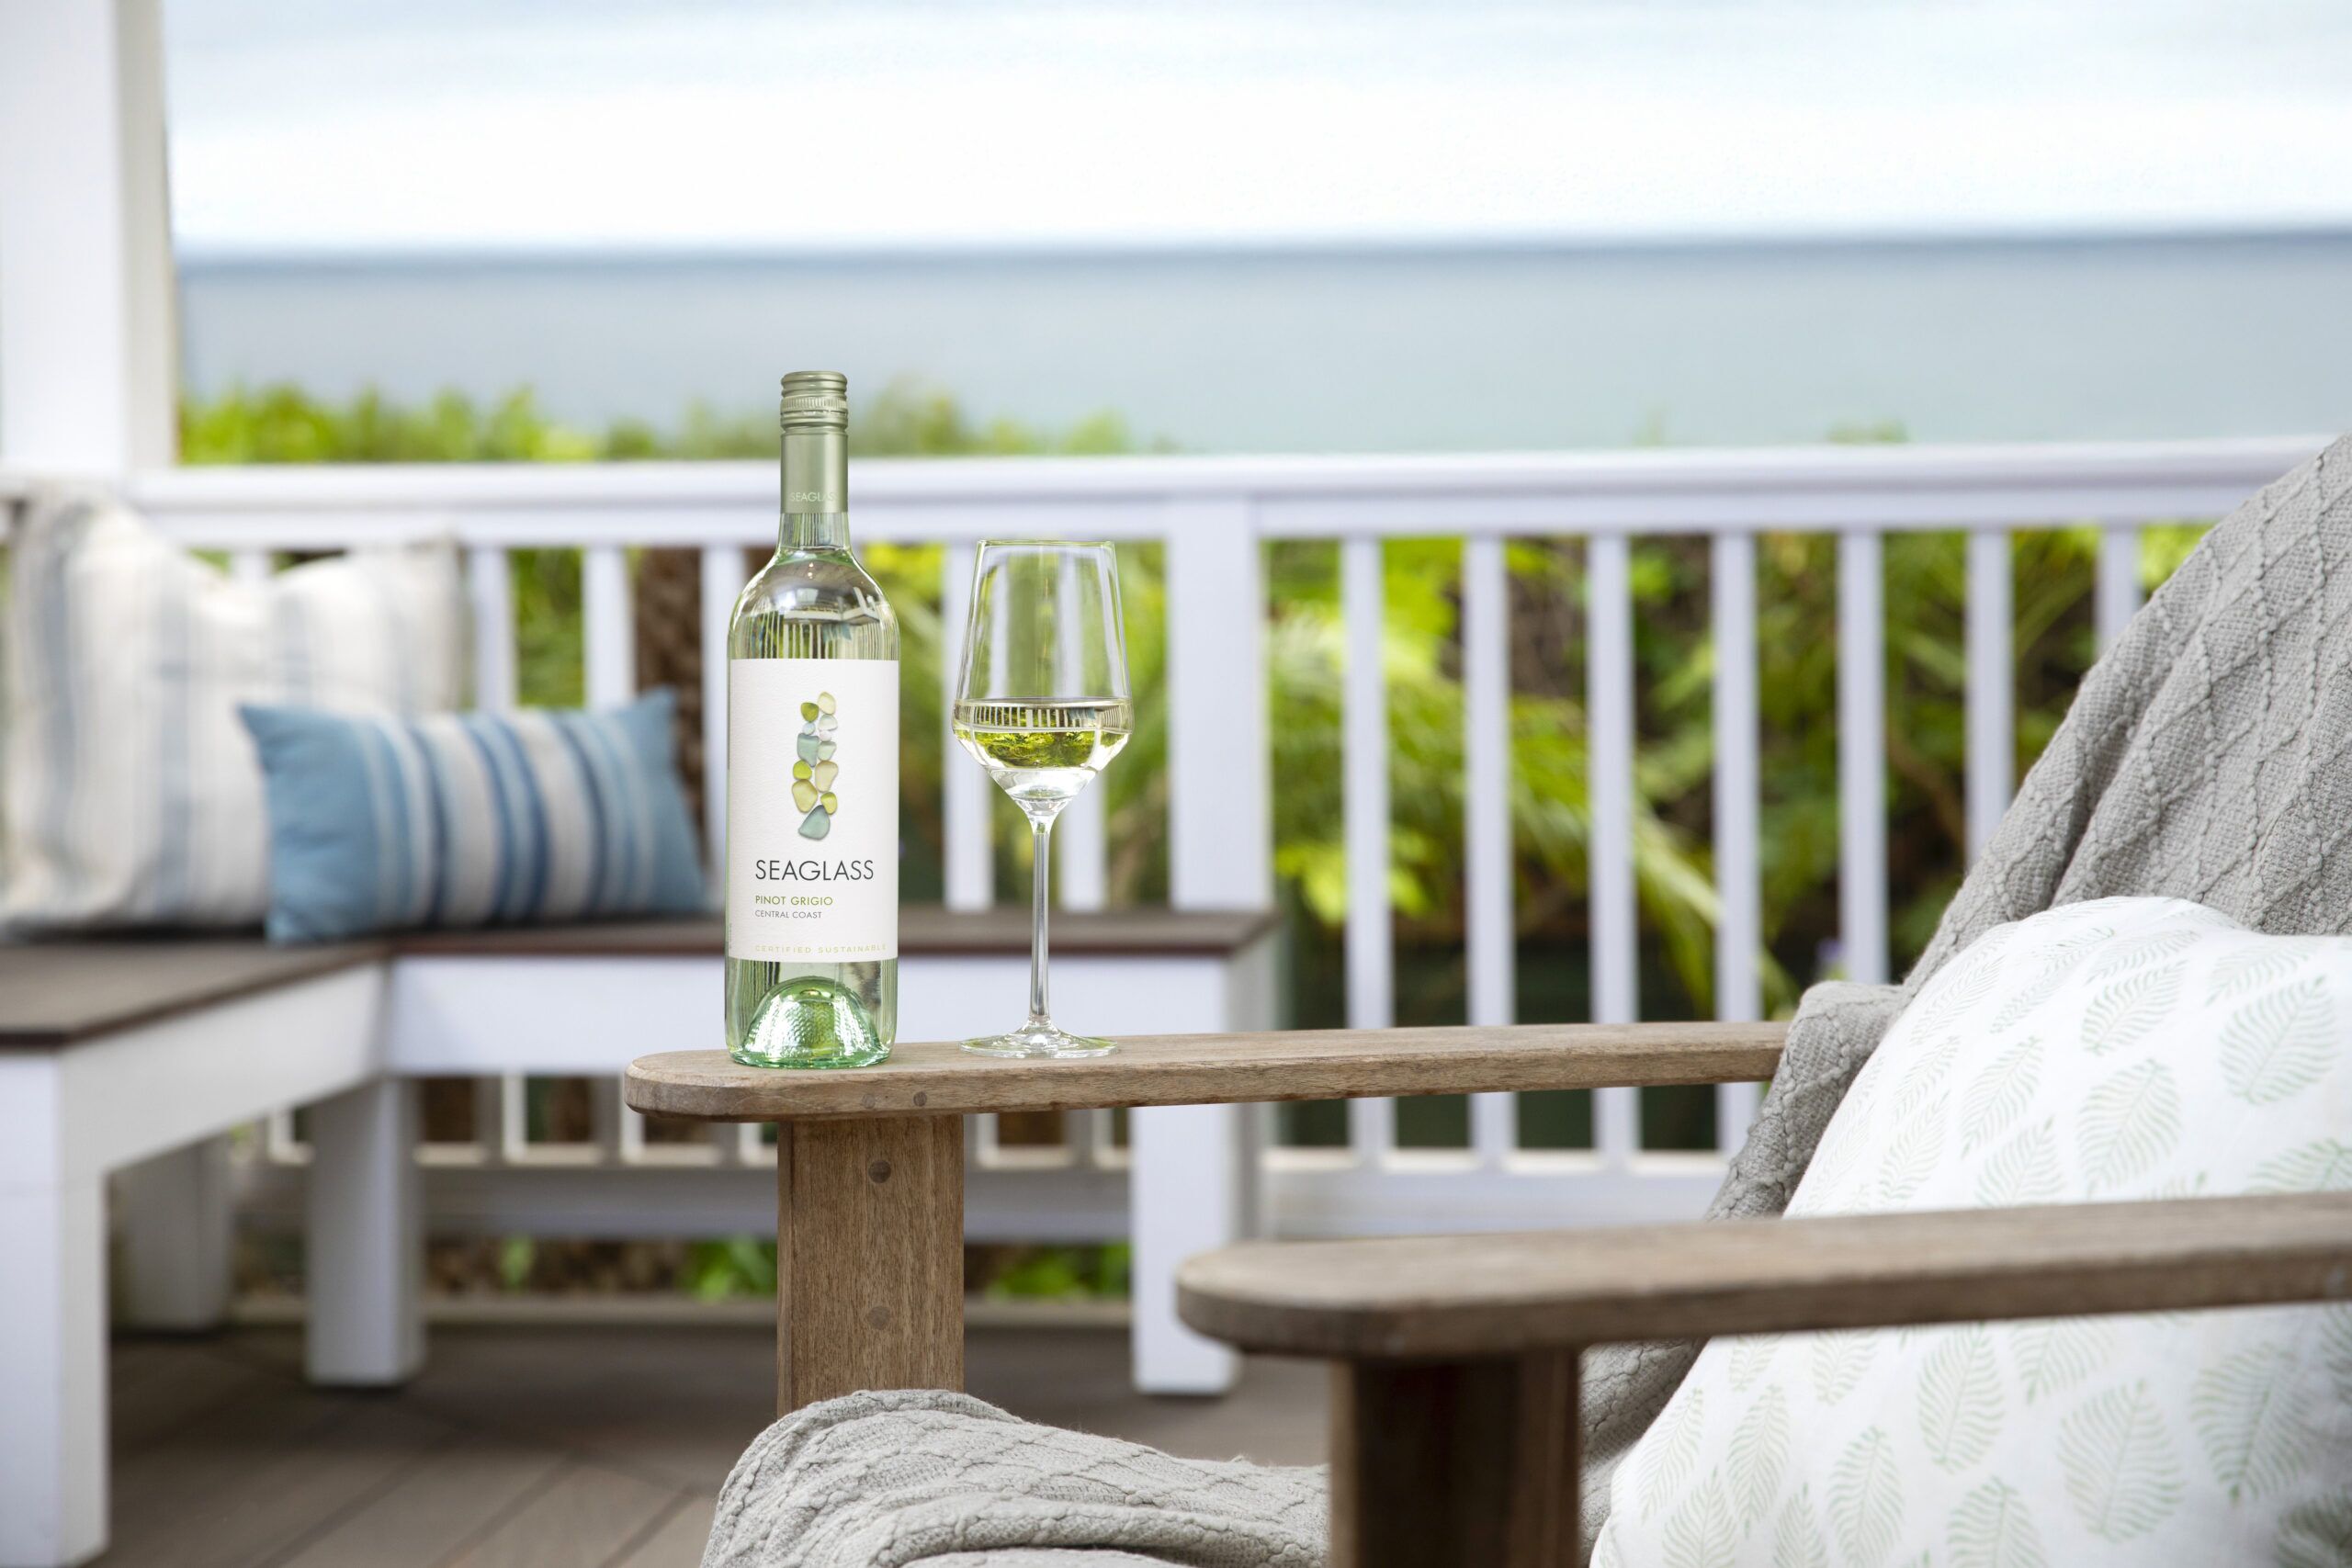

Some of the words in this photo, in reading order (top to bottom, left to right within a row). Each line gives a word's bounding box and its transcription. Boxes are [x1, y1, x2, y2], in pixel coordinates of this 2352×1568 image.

[755, 859, 874, 881] SEAGLASS
[755, 895, 786, 906] PINOT
[790, 896, 833, 906] GRIGIO
[754, 909, 790, 919] CENTRAL
[792, 910, 822, 919] COAST
[755, 944, 811, 953] CERTIFIED
[818, 943, 887, 953] SUSTAINABLE
